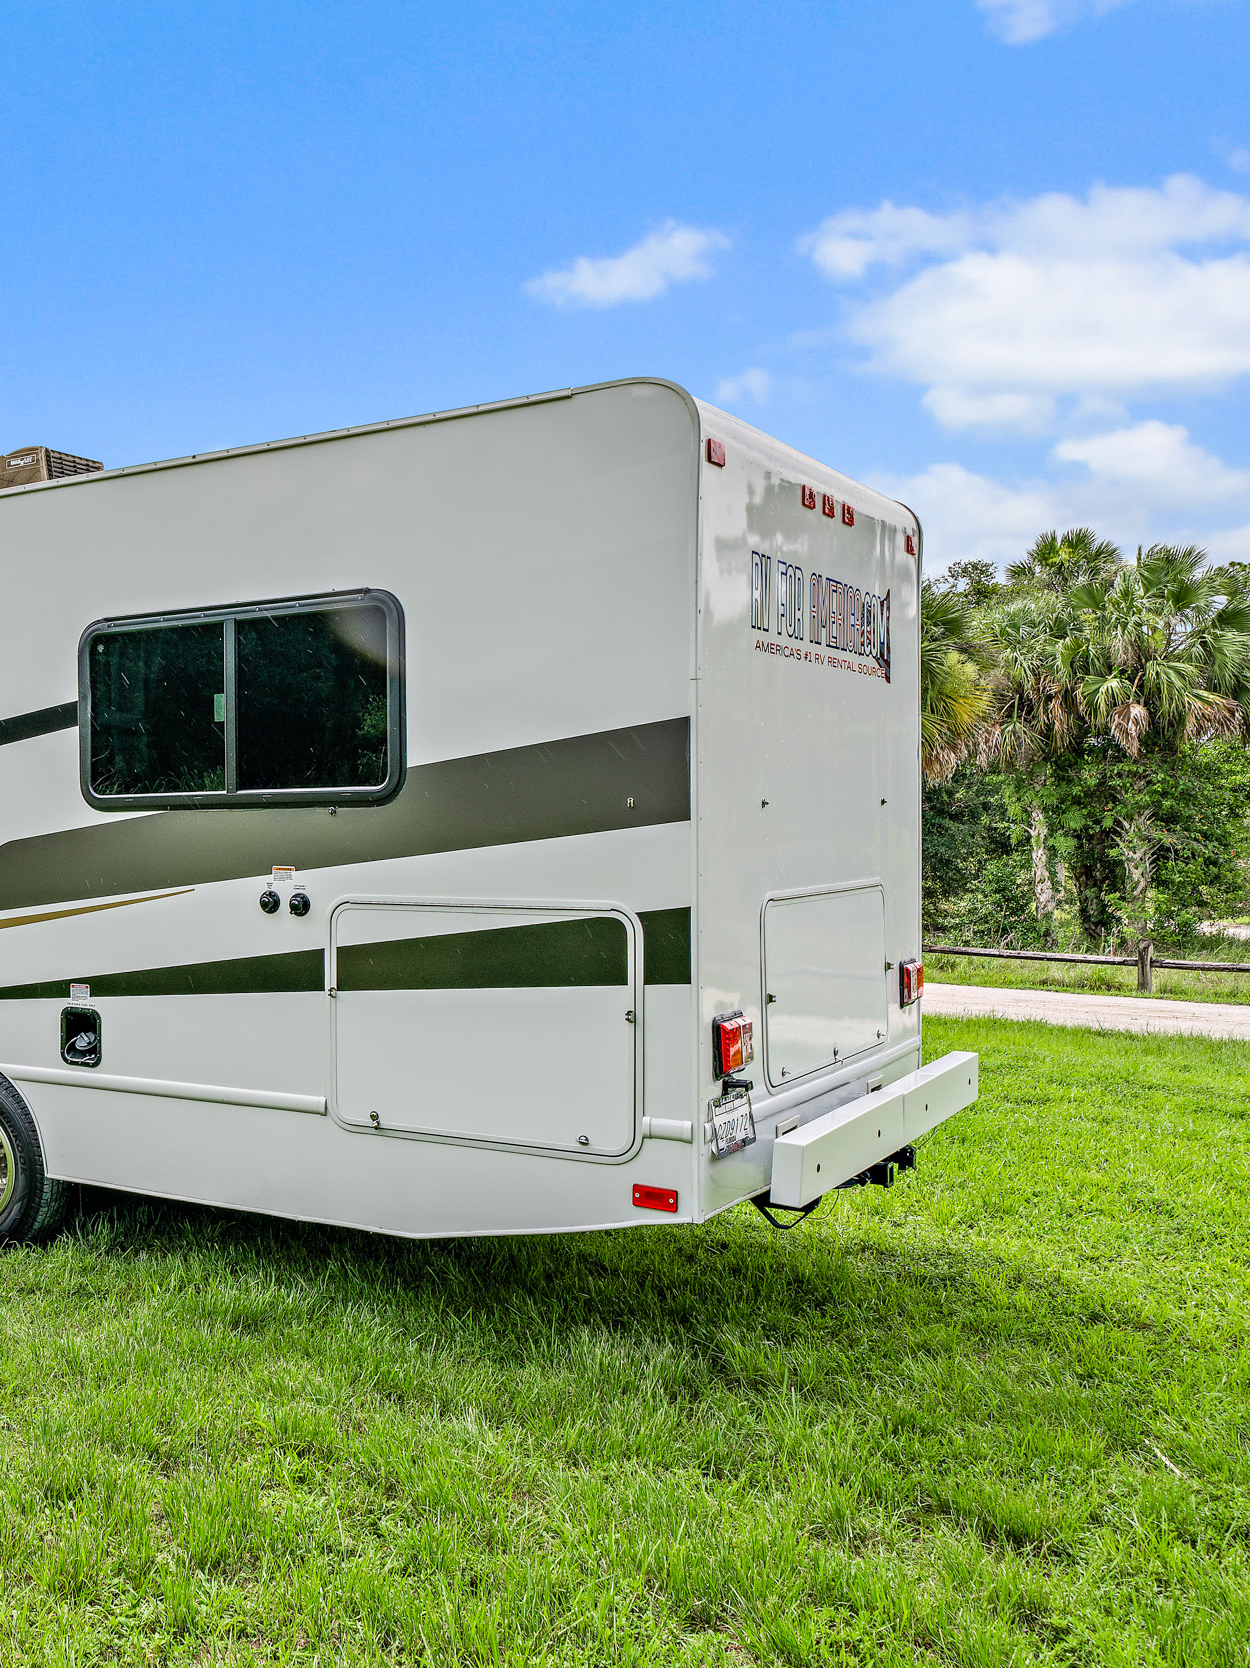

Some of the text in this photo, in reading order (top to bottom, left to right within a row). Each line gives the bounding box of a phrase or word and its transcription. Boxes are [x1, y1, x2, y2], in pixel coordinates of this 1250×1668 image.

[751, 550, 888, 661] RV FOR AMERICA.COM
[755, 640, 885, 678] AMERICA'S #1 RV RENTAL SOURCE
